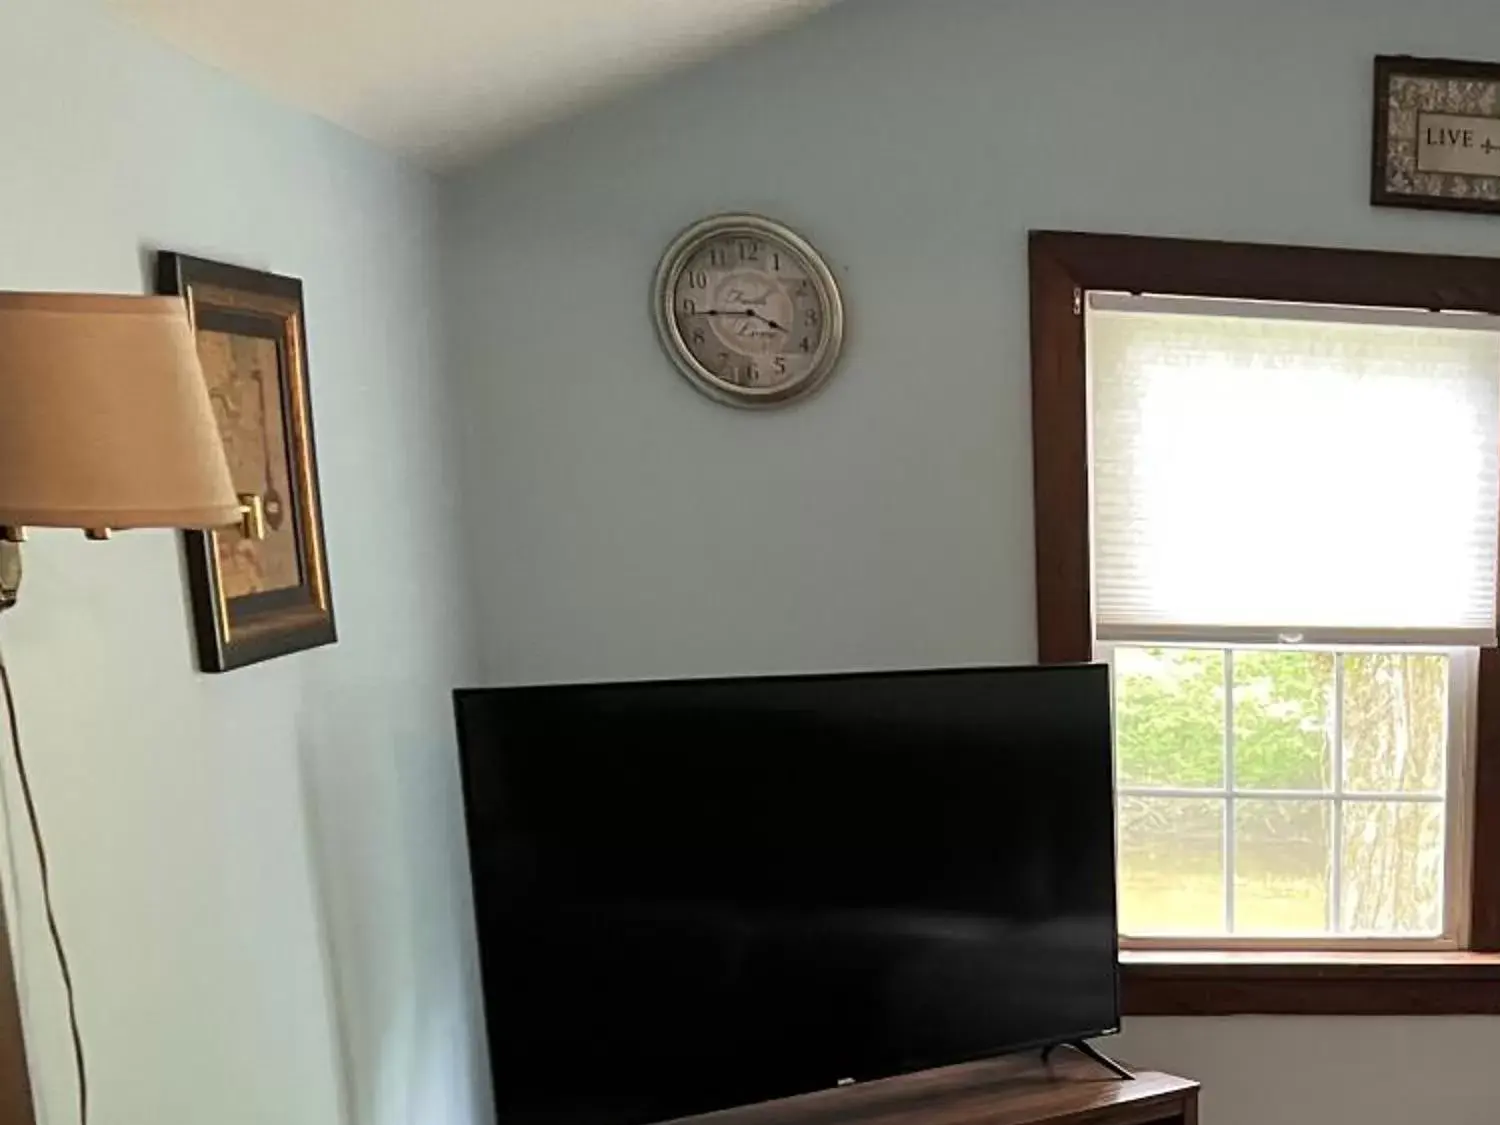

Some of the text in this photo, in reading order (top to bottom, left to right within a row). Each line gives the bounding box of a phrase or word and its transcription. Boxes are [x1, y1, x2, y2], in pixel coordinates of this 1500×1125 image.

[1426, 127, 1473, 148] LIVE
[710, 250, 725, 266] 11
[739, 242, 759, 260] 12
[772, 253, 780, 272] 1
[687, 271, 707, 289] 10
[746, 363, 759, 379] 6
[773, 357, 786, 375] 5
